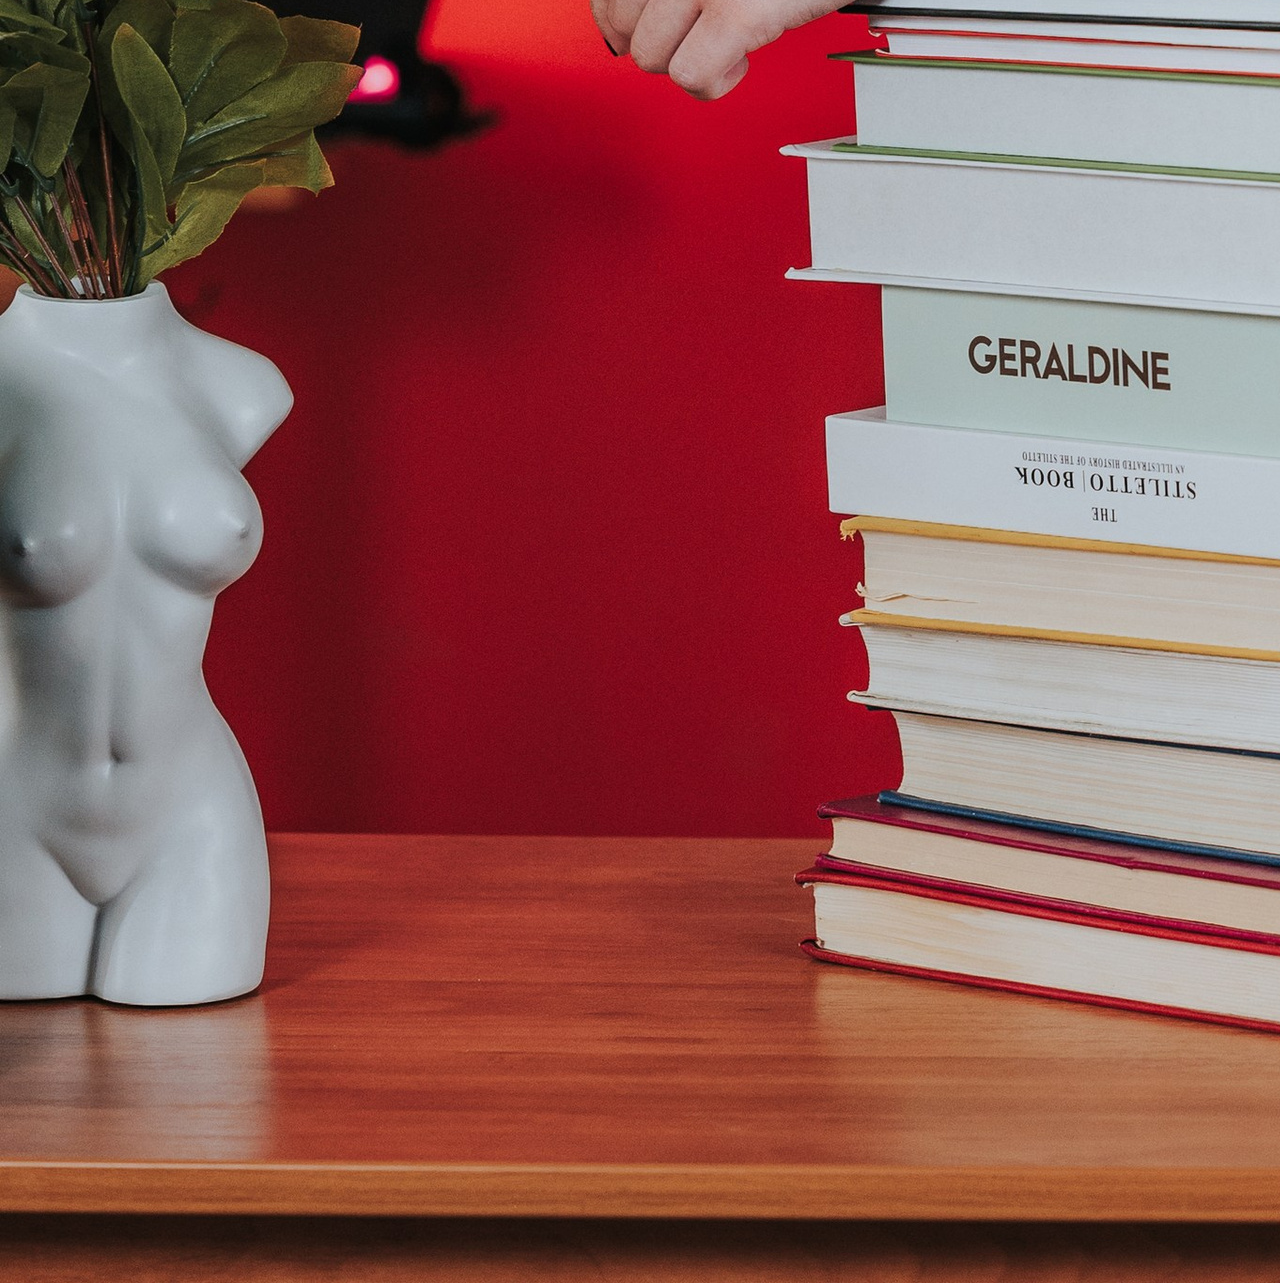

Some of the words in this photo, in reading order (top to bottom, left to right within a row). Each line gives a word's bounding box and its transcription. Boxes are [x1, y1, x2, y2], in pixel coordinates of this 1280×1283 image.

[968, 335, 1171, 391] GERALDINE
[1022, 451, 1058, 464] STILETTO
[1059, 454, 1074, 465] THE
[1077, 455, 1086, 466] OF
[1088, 457, 1121, 469] HISTORY
[1122, 459, 1173, 474] ILLUSTRATED
[1174, 464, 1186, 475] AN
[1014, 466, 1075, 489] BOOK
[1090, 473, 1197, 500] STILETTO
[1091, 506, 1118, 523] THE
